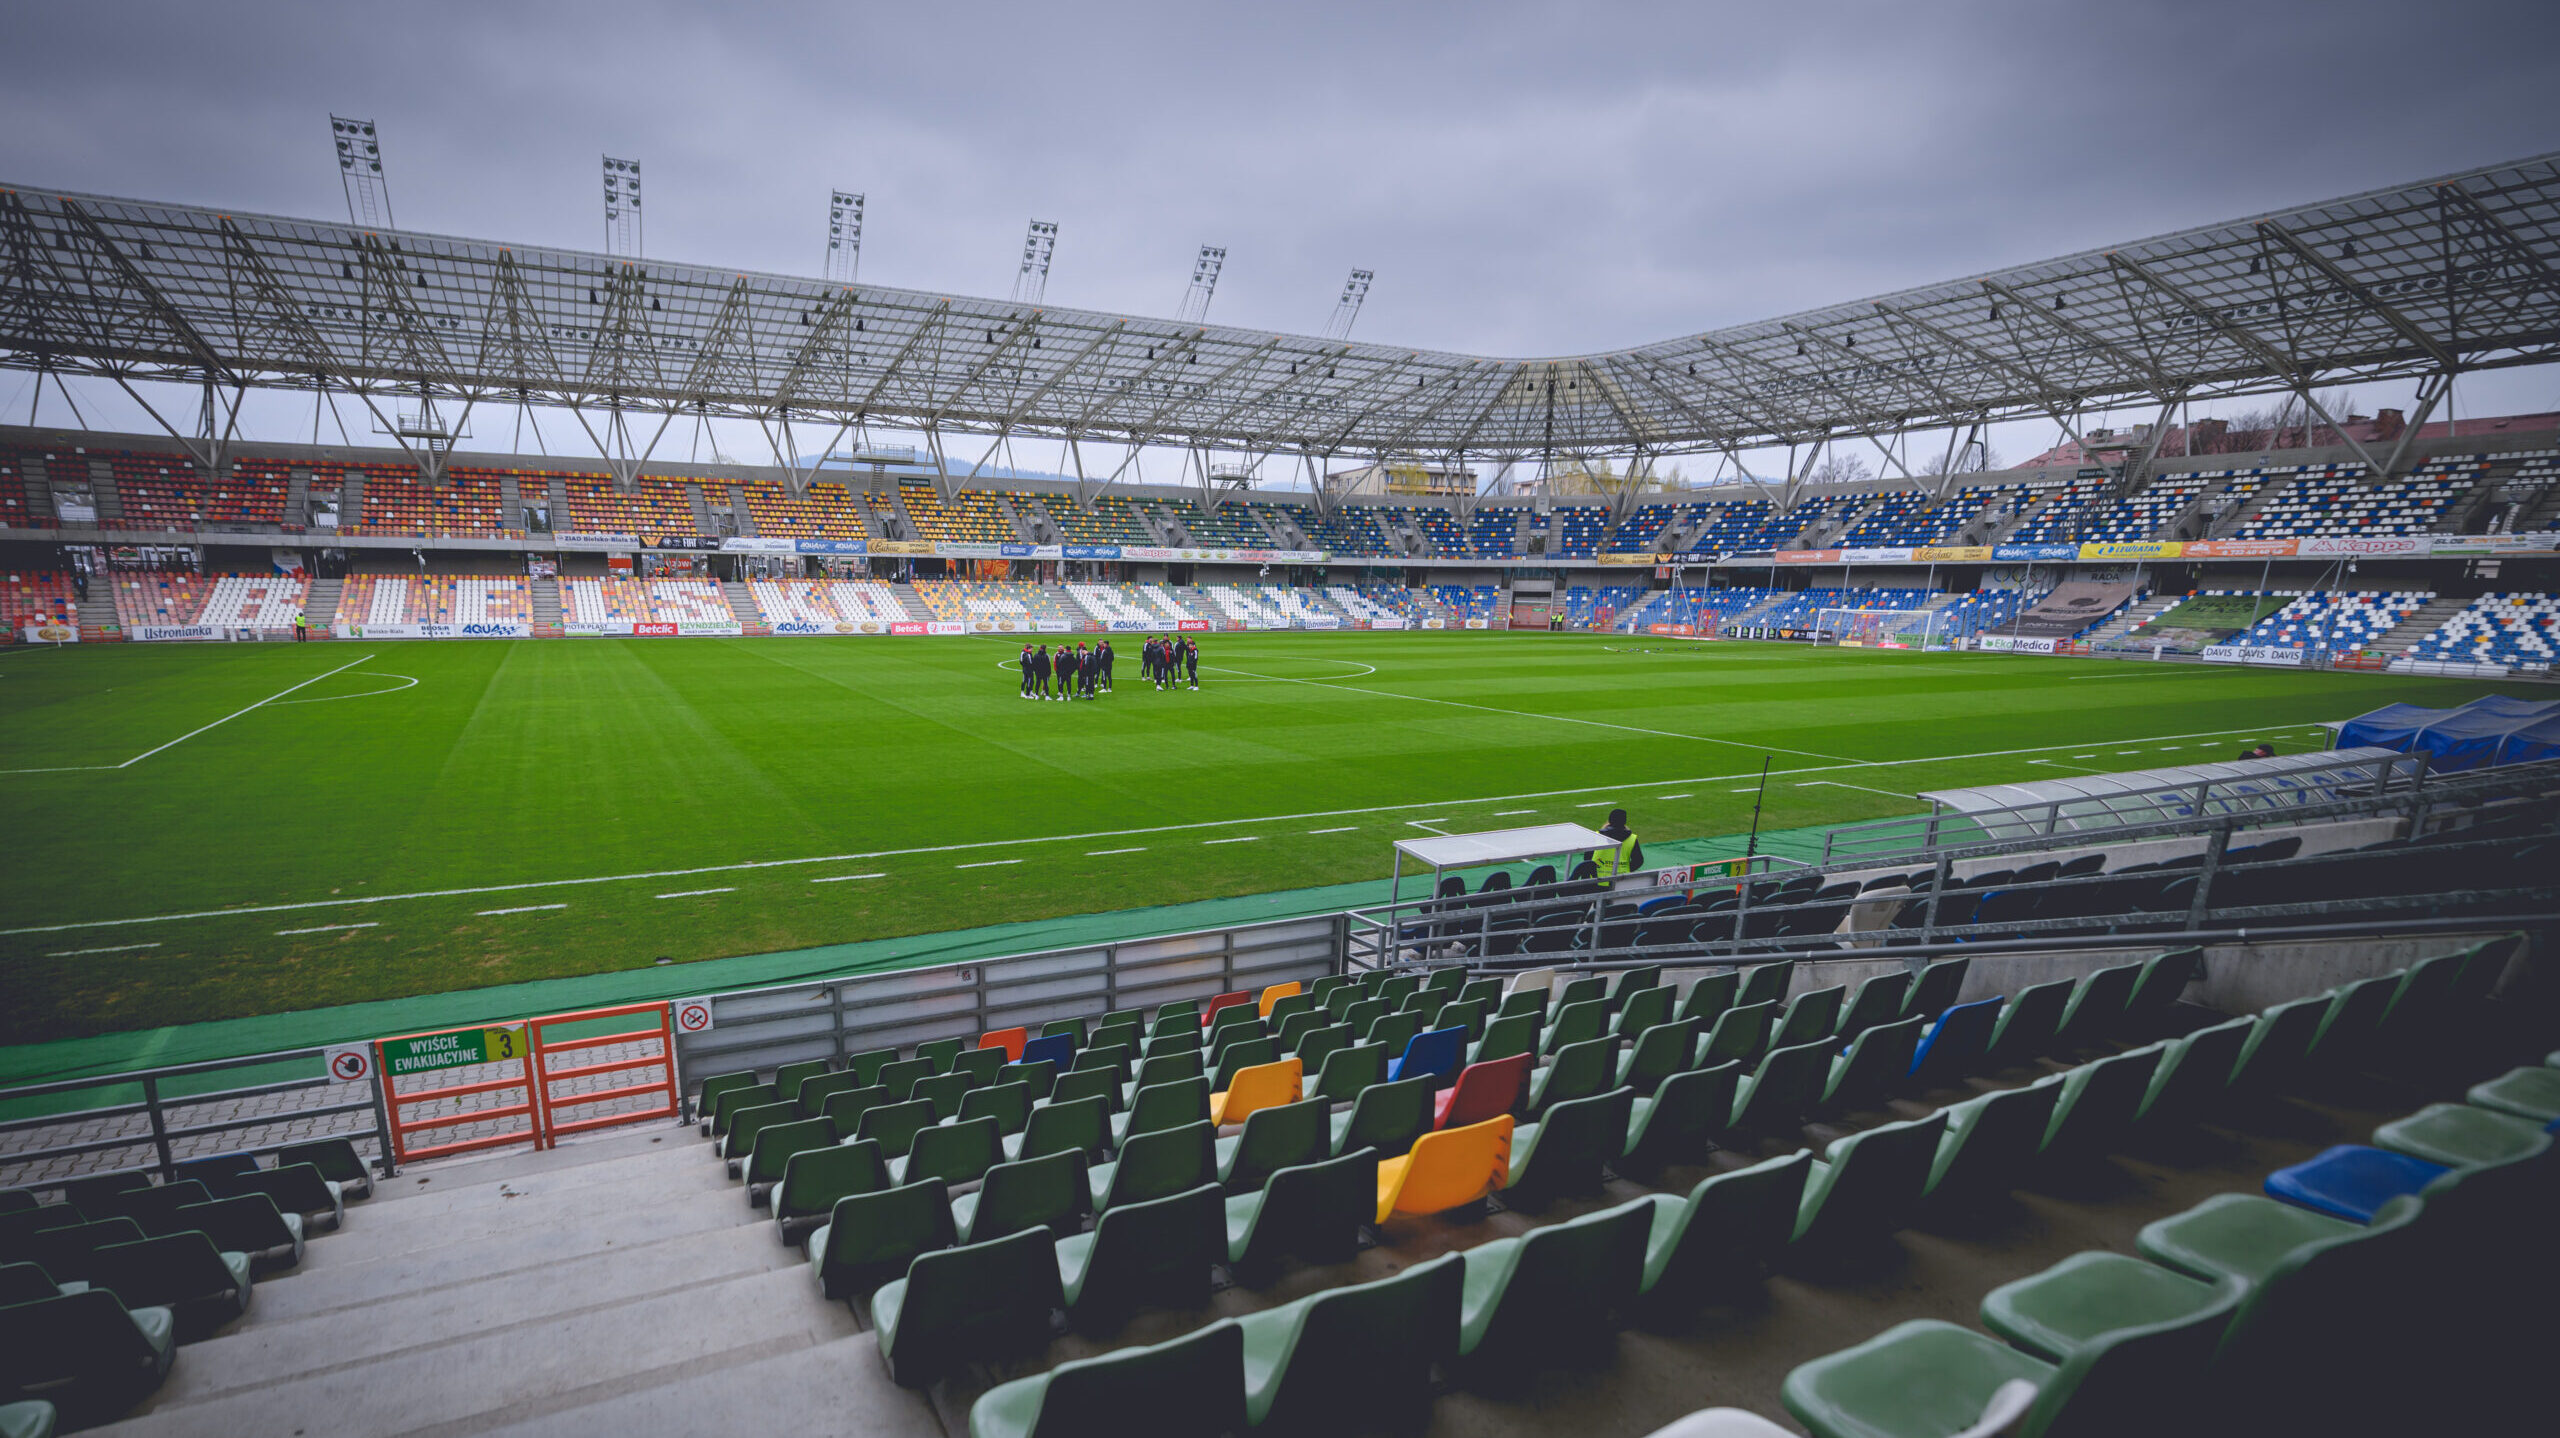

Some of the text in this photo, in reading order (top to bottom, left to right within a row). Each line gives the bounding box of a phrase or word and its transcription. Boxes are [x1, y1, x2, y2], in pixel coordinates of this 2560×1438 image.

[682, 538, 697, 547] FIAT
[2337, 540, 2416, 552] Kappa
[2114, 544, 2162, 553] LEWIATAN
[638, 624, 673, 634] Betclic
[679, 621, 740, 629] SZYNDZIELNIA
[895, 624, 923, 633] Betclic
[1181, 621, 1206, 630] Betclic
[144, 625, 212, 639] Ustronianka
[2206, 647, 2300, 660] DAVIS DAVIS DAVIS
[409, 1036, 459, 1054] WYJŚCIE
[499, 1033, 513, 1058] 3
[394, 1047, 480, 1072] EWAKUACYJNE
